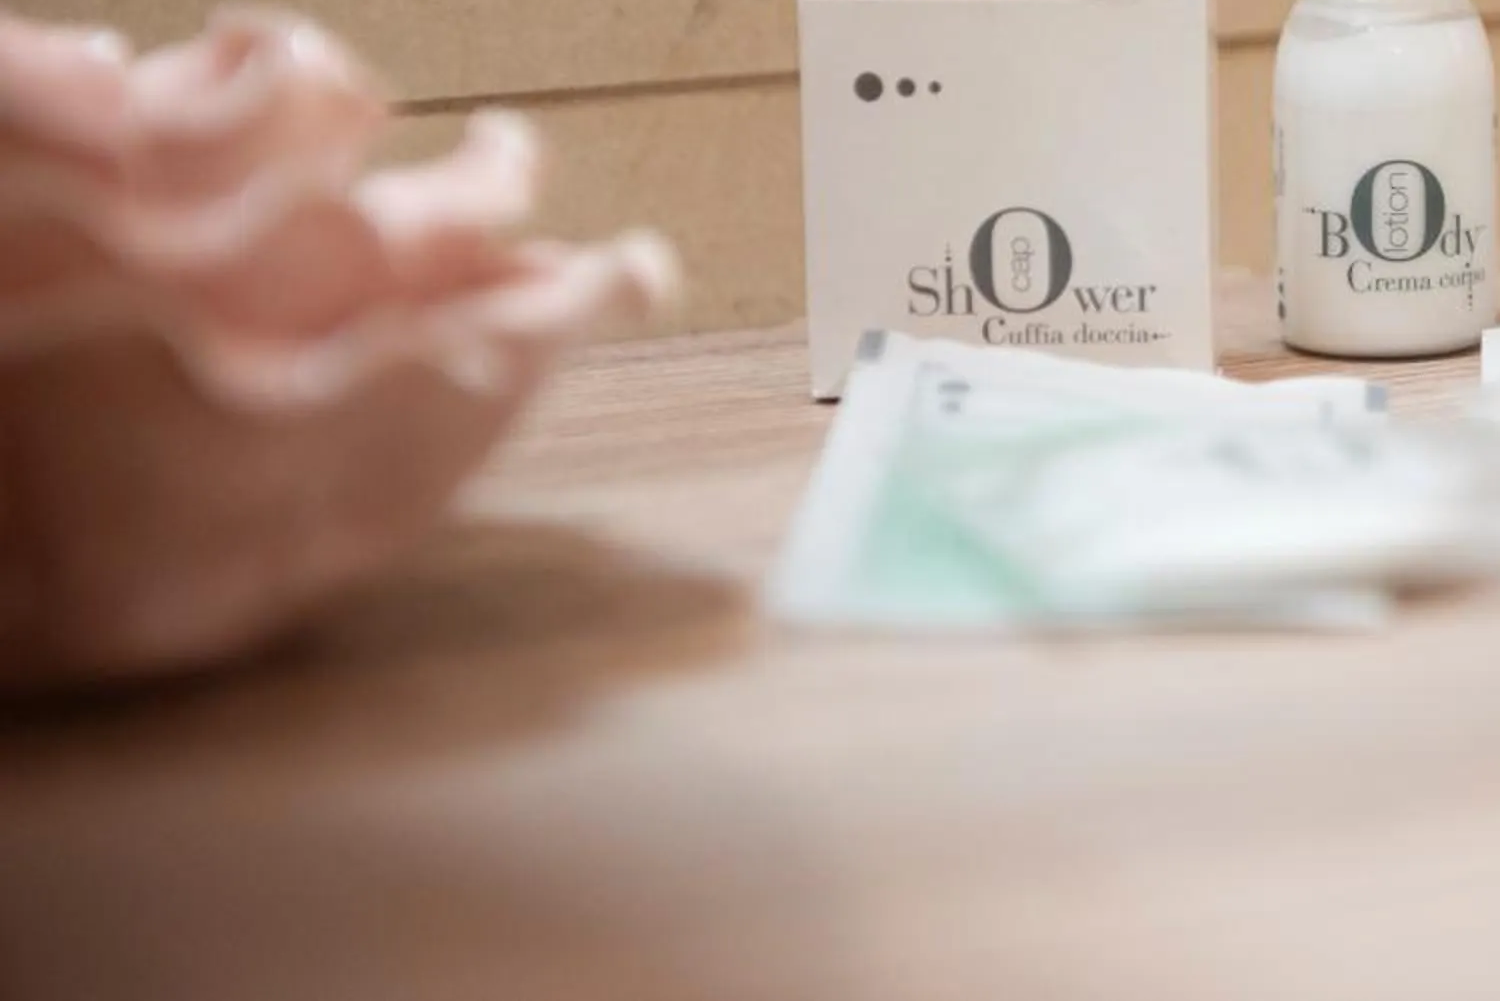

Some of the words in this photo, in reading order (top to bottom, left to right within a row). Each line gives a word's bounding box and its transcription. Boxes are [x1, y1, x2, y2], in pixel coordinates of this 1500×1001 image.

[1383, 172, 1409, 253] lotion
[1009, 236, 1035, 293] cap
[1346, 260, 1432, 294] Crema
[981, 317, 1064, 346] Cuffia
[1073, 322, 1150, 345] doccia
